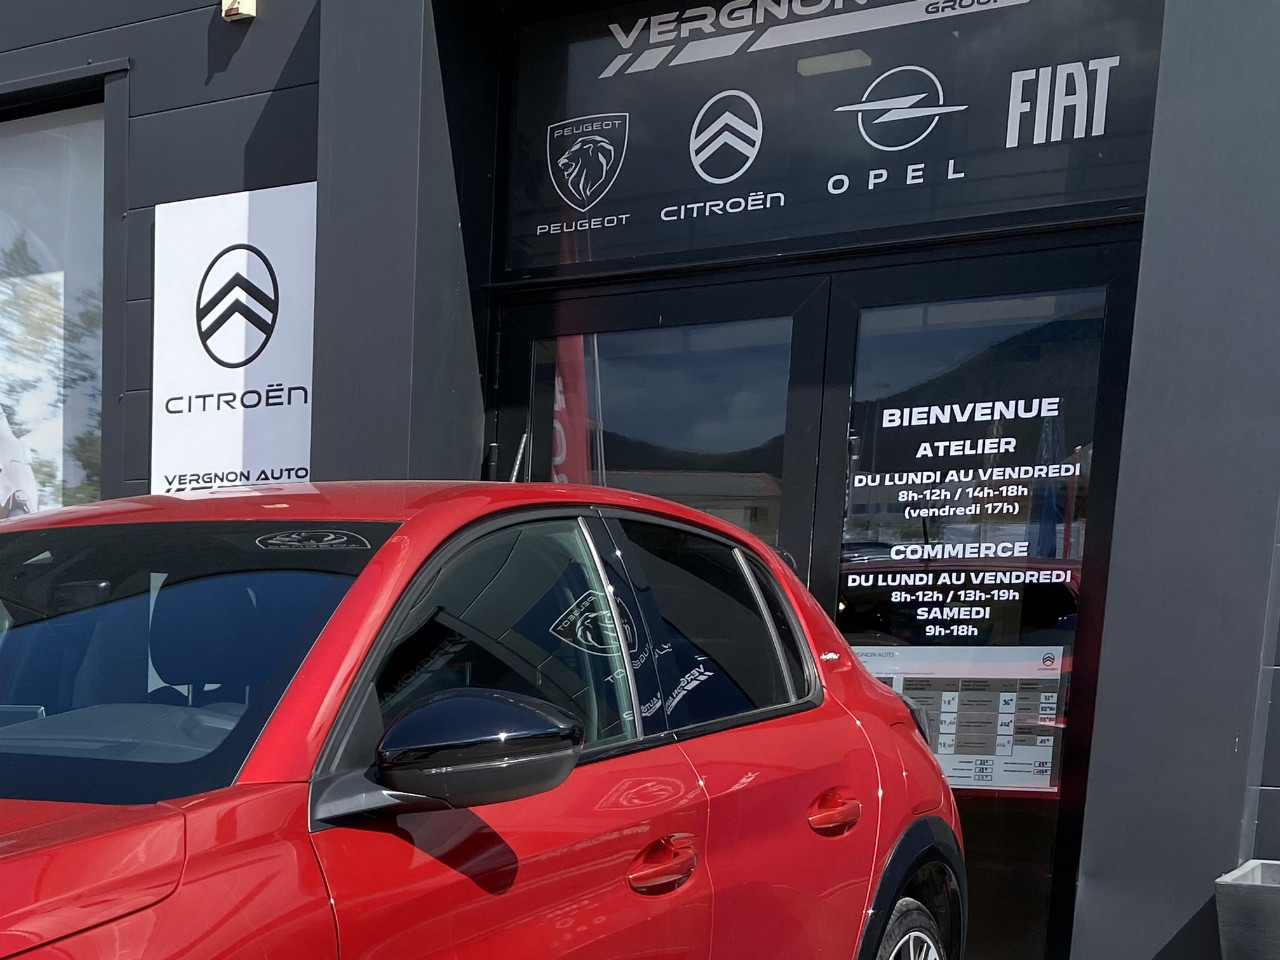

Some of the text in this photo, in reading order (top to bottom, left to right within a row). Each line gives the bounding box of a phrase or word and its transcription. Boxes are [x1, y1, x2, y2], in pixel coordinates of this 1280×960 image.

[925, 0, 998, 14] GROU
[1006, 56, 1119, 148] FIAT
[554, 120, 621, 138] PEUGEOT
[827, 159, 964, 194] OPEL
[660, 192, 785, 221] CITROËN
[537, 214, 630, 235] PEUGEOT
[165, 383, 308, 414] CITROËN
[882, 398, 1060, 427] BIENVENUE
[916, 437, 1016, 458] ATELIER
[164, 467, 309, 486] VERGNON AUTO
[854, 463, 1081, 487] DU LUNDI AU VENDREDI
[898, 488, 951, 502] 8h-12h
[966, 485, 1028, 499] 14h-18h
[904, 502, 1020, 519] (vendredi 17h)
[890, 541, 1029, 560] COMMERCE
[847, 570, 1071, 587] DU LUNDI AU VENDREDI
[891, 590, 943, 602] 8h-12h
[958, 589, 1019, 601] 13h-19h
[917, 606, 990, 620] SAMEDI
[925, 624, 978, 636] 9h-18h
